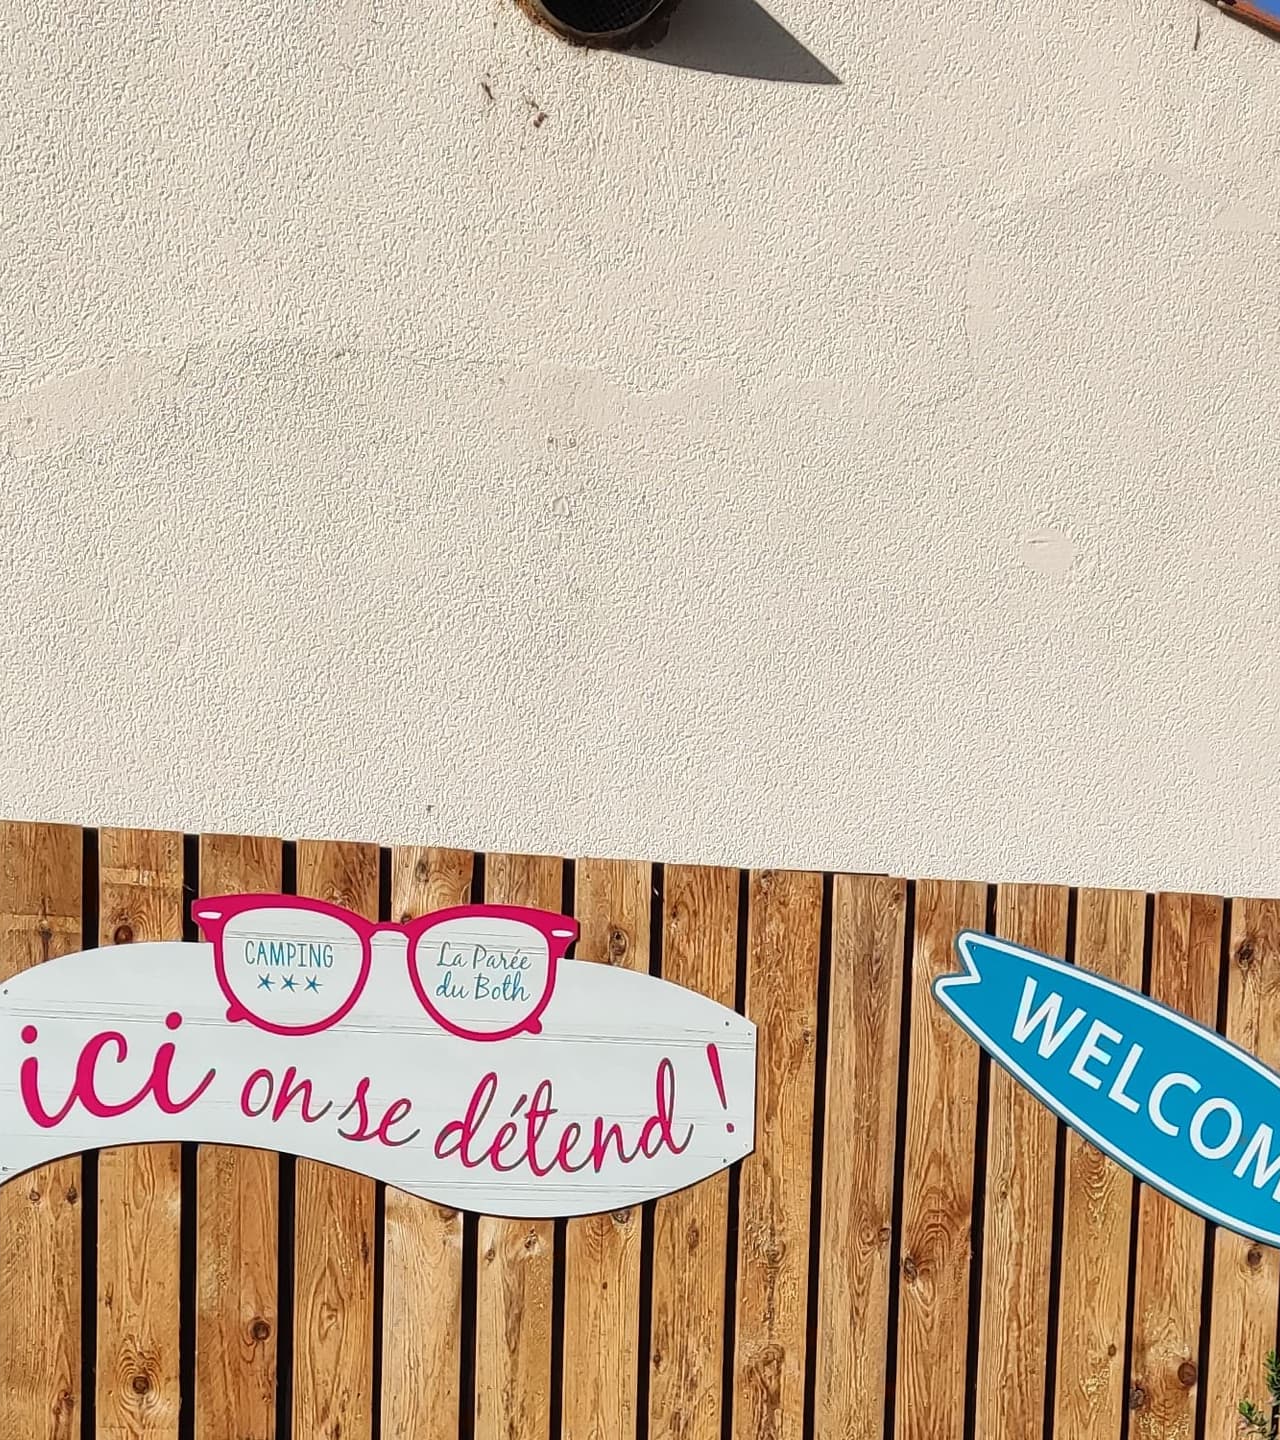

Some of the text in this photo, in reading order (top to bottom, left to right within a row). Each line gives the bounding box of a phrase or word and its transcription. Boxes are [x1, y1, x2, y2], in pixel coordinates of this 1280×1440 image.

[244, 940, 334, 968] CAMPING
[436, 941, 532, 970] La Parée
[435, 970, 531, 1001] du Both
[18, 1012, 737, 1176] ici on se détend !
